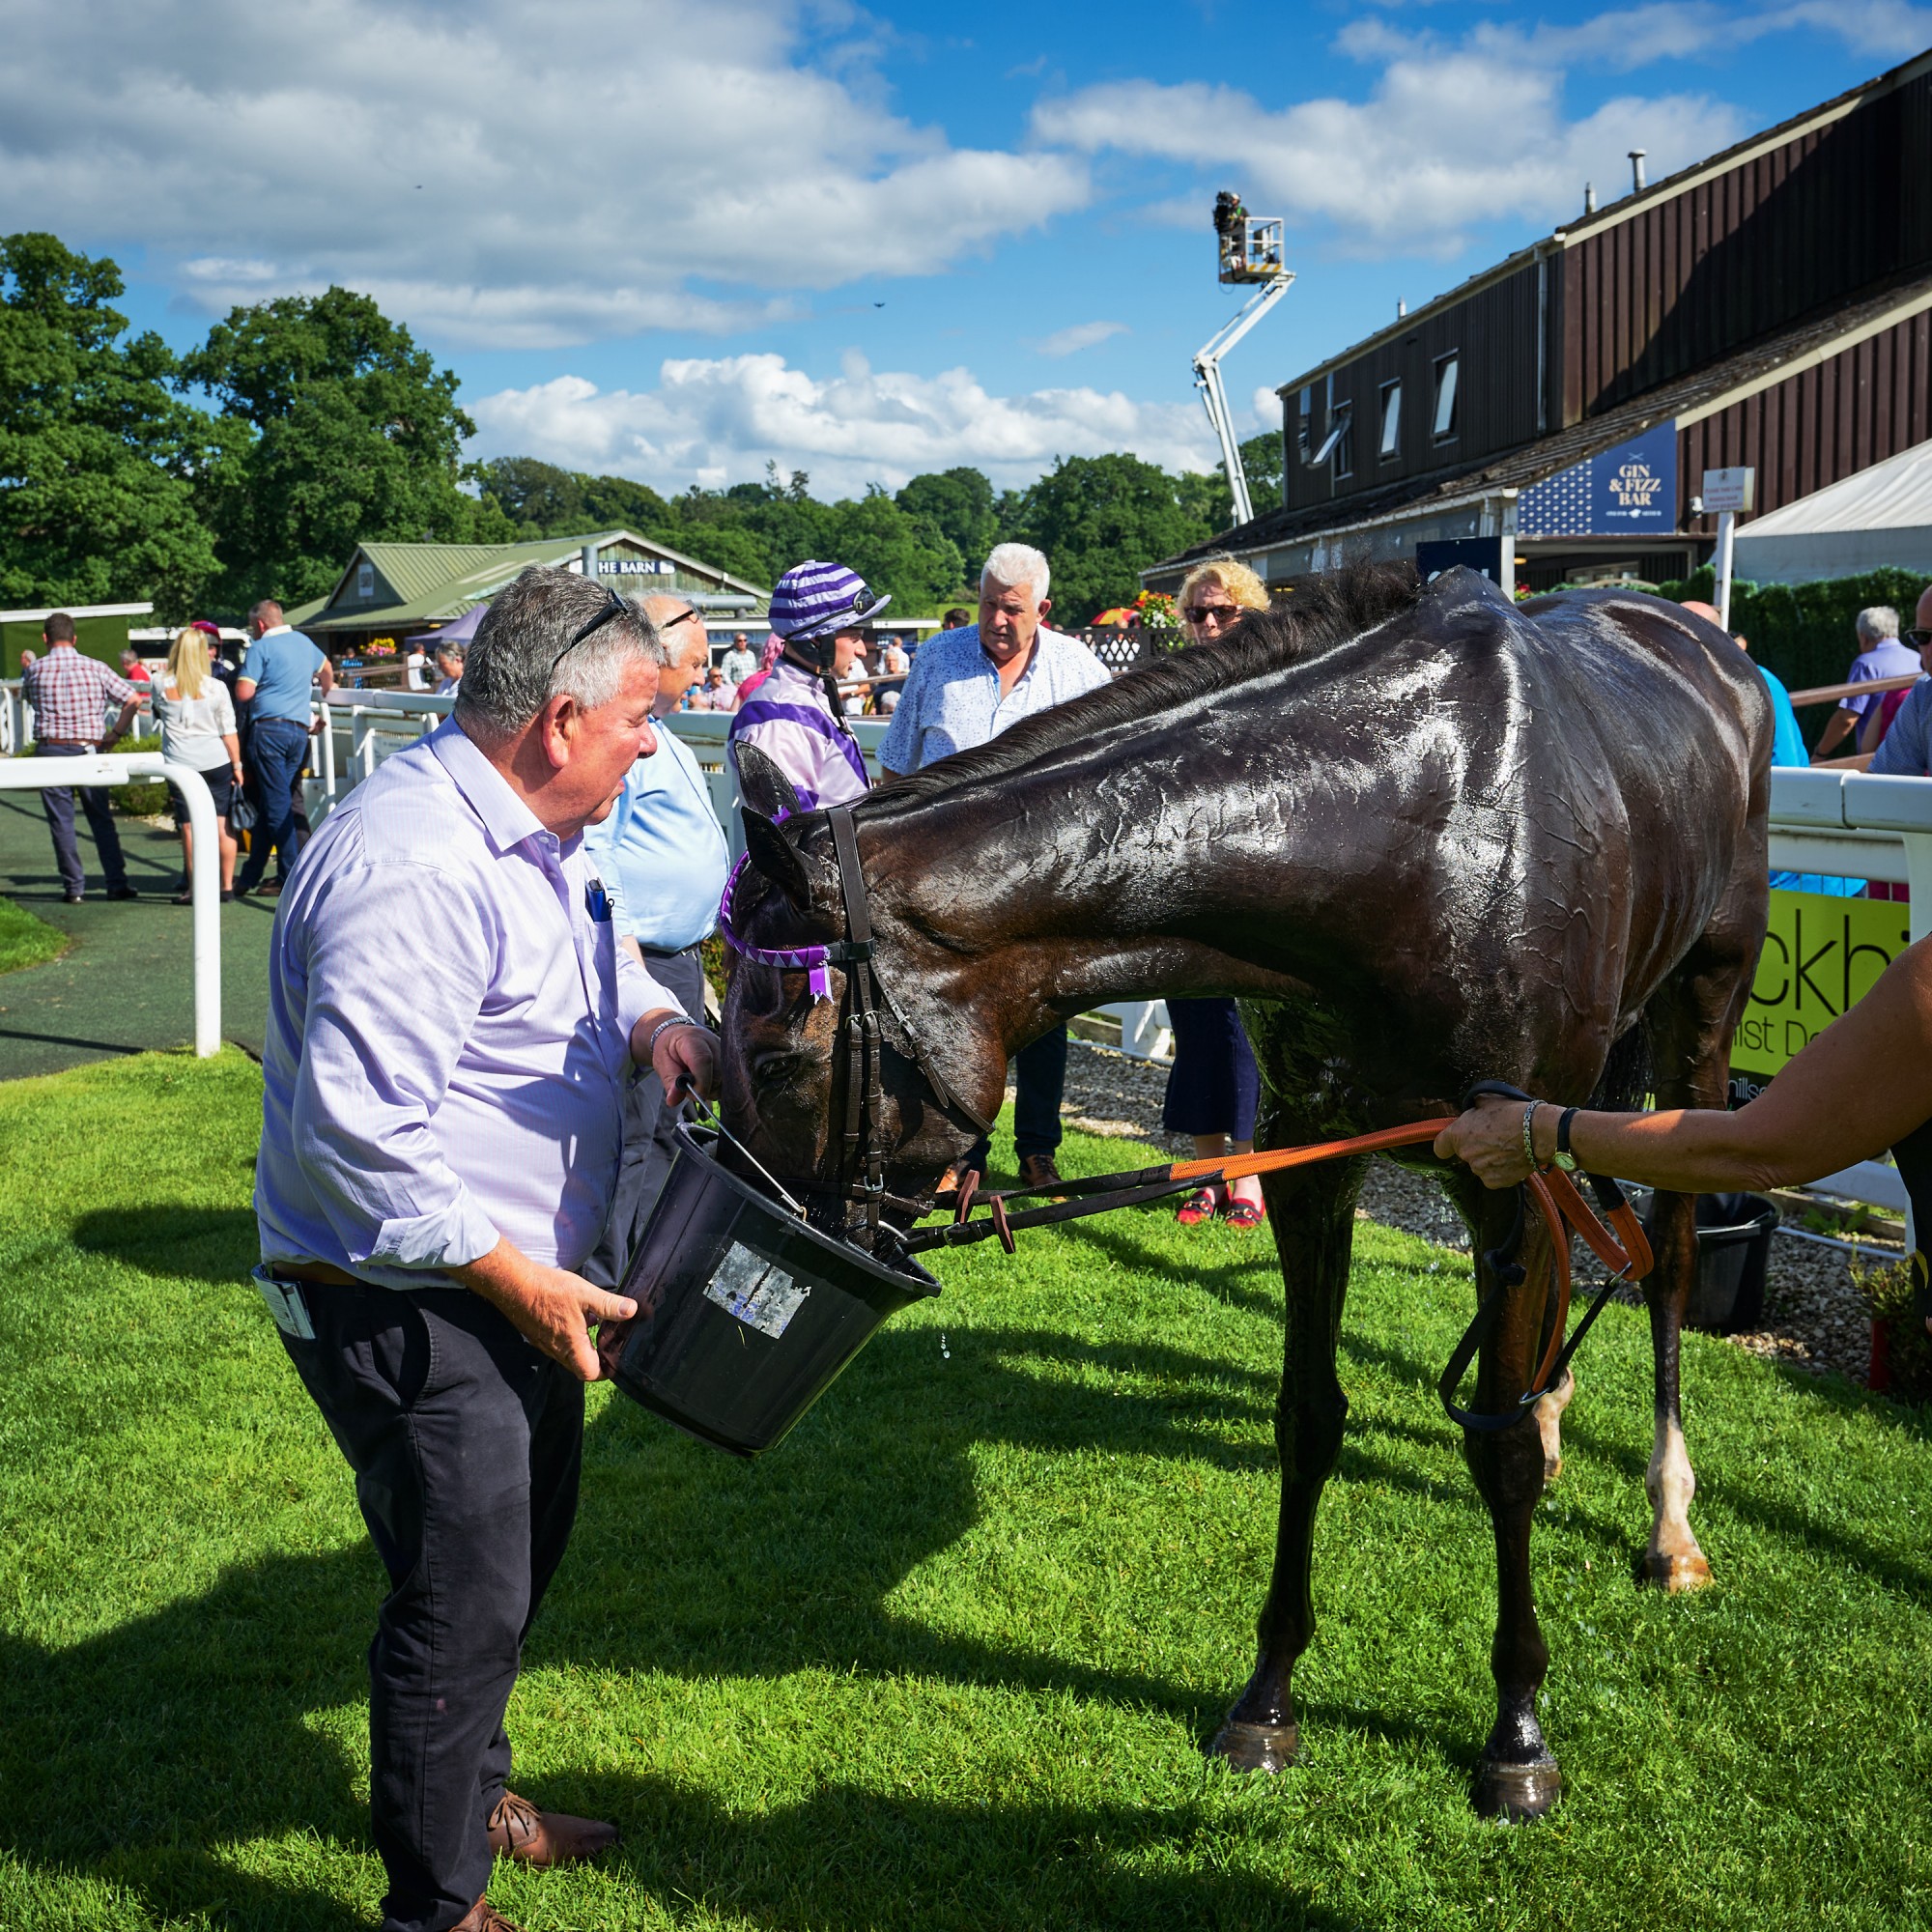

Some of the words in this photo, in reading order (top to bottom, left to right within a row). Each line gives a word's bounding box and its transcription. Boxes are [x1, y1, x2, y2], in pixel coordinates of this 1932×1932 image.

[1619, 465, 1650, 477] GIN
[1608, 478, 1623, 492] &
[1625, 478, 1662, 492] FIZZ
[1619, 493, 1652, 505] BAR
[599, 561, 617, 573] HE
[620, 561, 655, 573] BARN
[1750, 909, 1909, 1016] ckh
[1785, 1020, 1821, 1057] D
